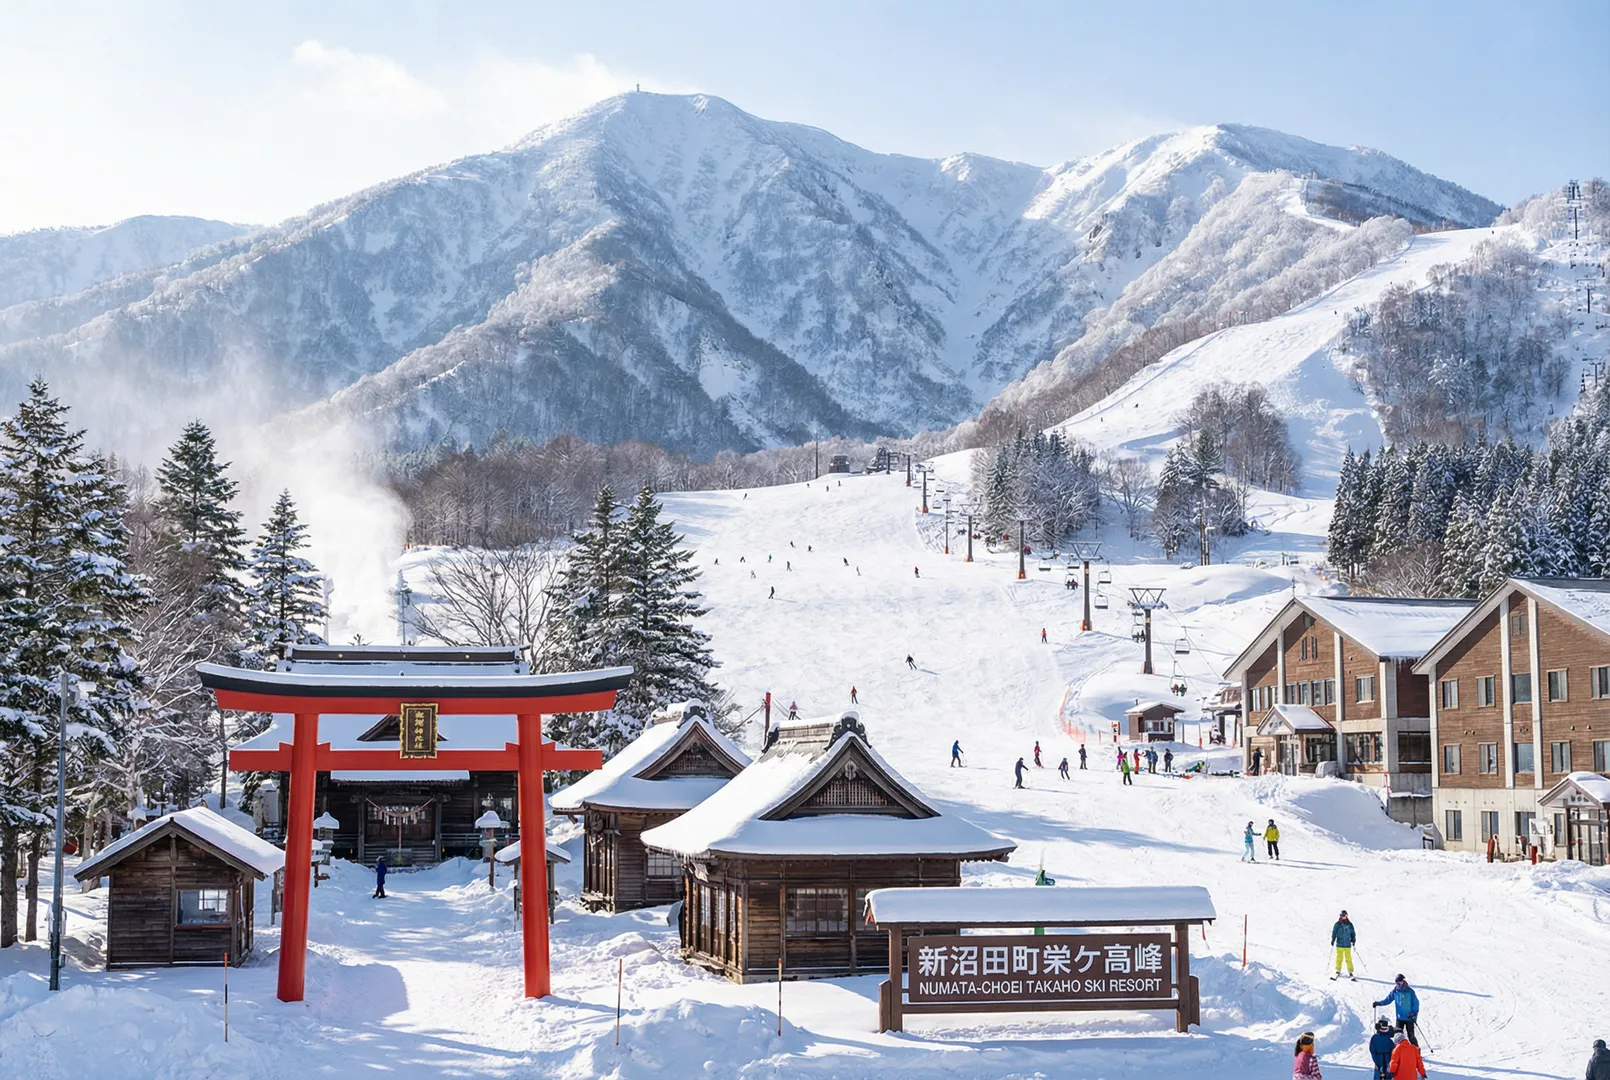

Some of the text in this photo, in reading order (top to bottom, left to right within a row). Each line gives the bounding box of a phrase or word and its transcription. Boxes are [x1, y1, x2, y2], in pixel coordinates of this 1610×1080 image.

[918, 943, 1163, 976] 新沼田町栄ケ高峰
[919, 978, 1163, 995] NUMATA-CHOEI TAKAHO SKI RESORT
